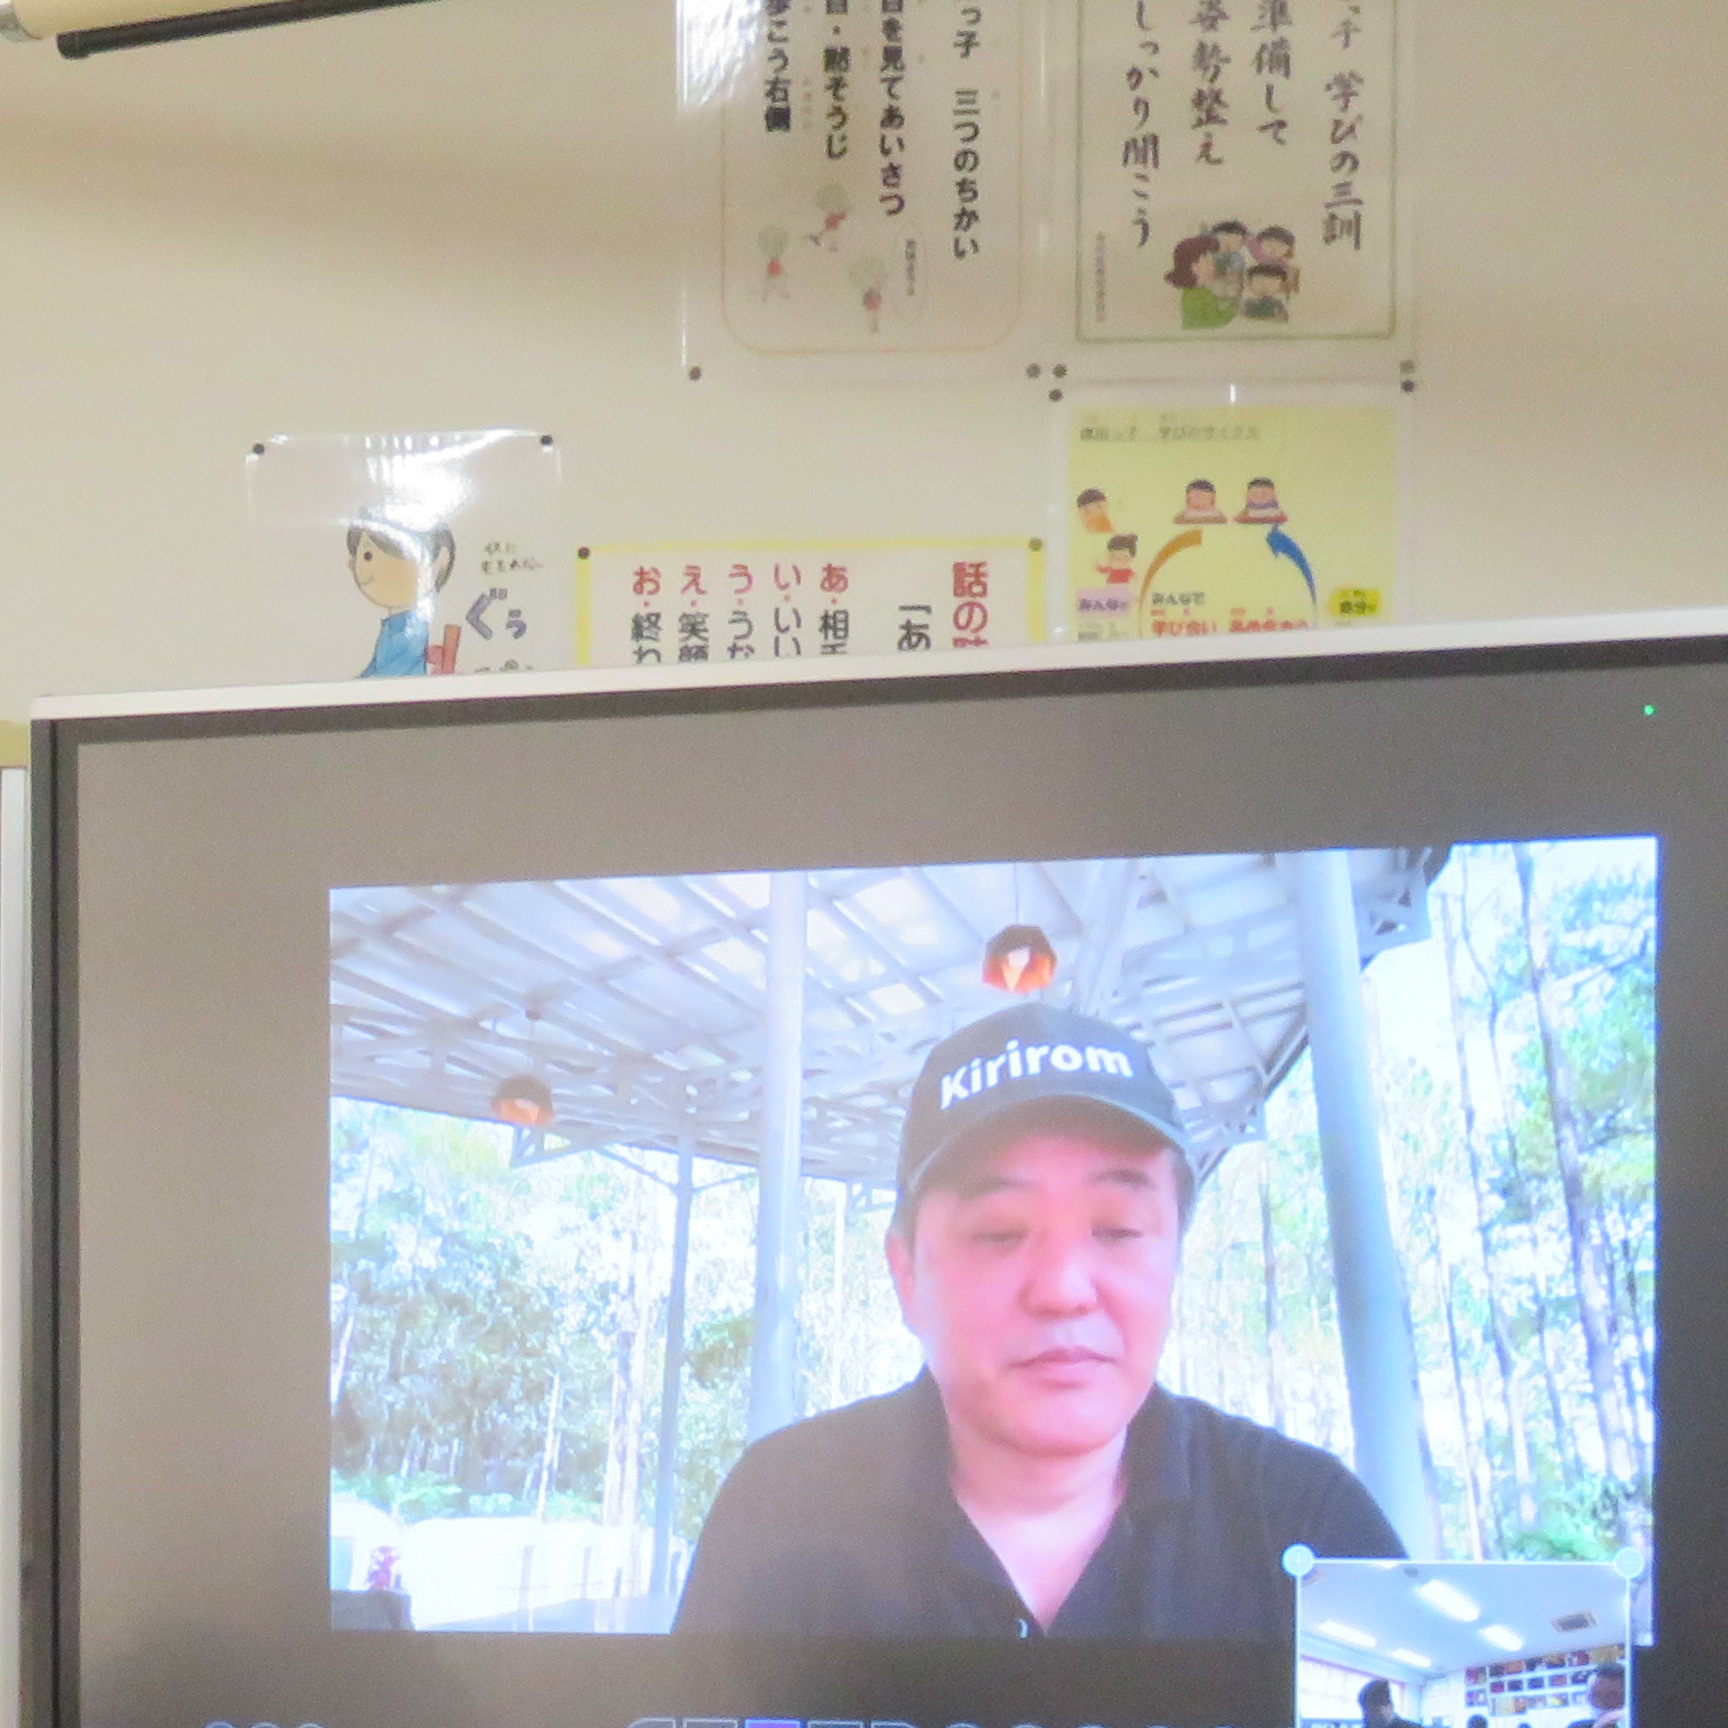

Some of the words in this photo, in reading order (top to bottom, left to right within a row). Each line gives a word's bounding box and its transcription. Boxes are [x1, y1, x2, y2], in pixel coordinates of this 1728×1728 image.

[953, 88, 982, 260] 三つのちかい
[940, 1037, 1134, 1111] Kirirom
